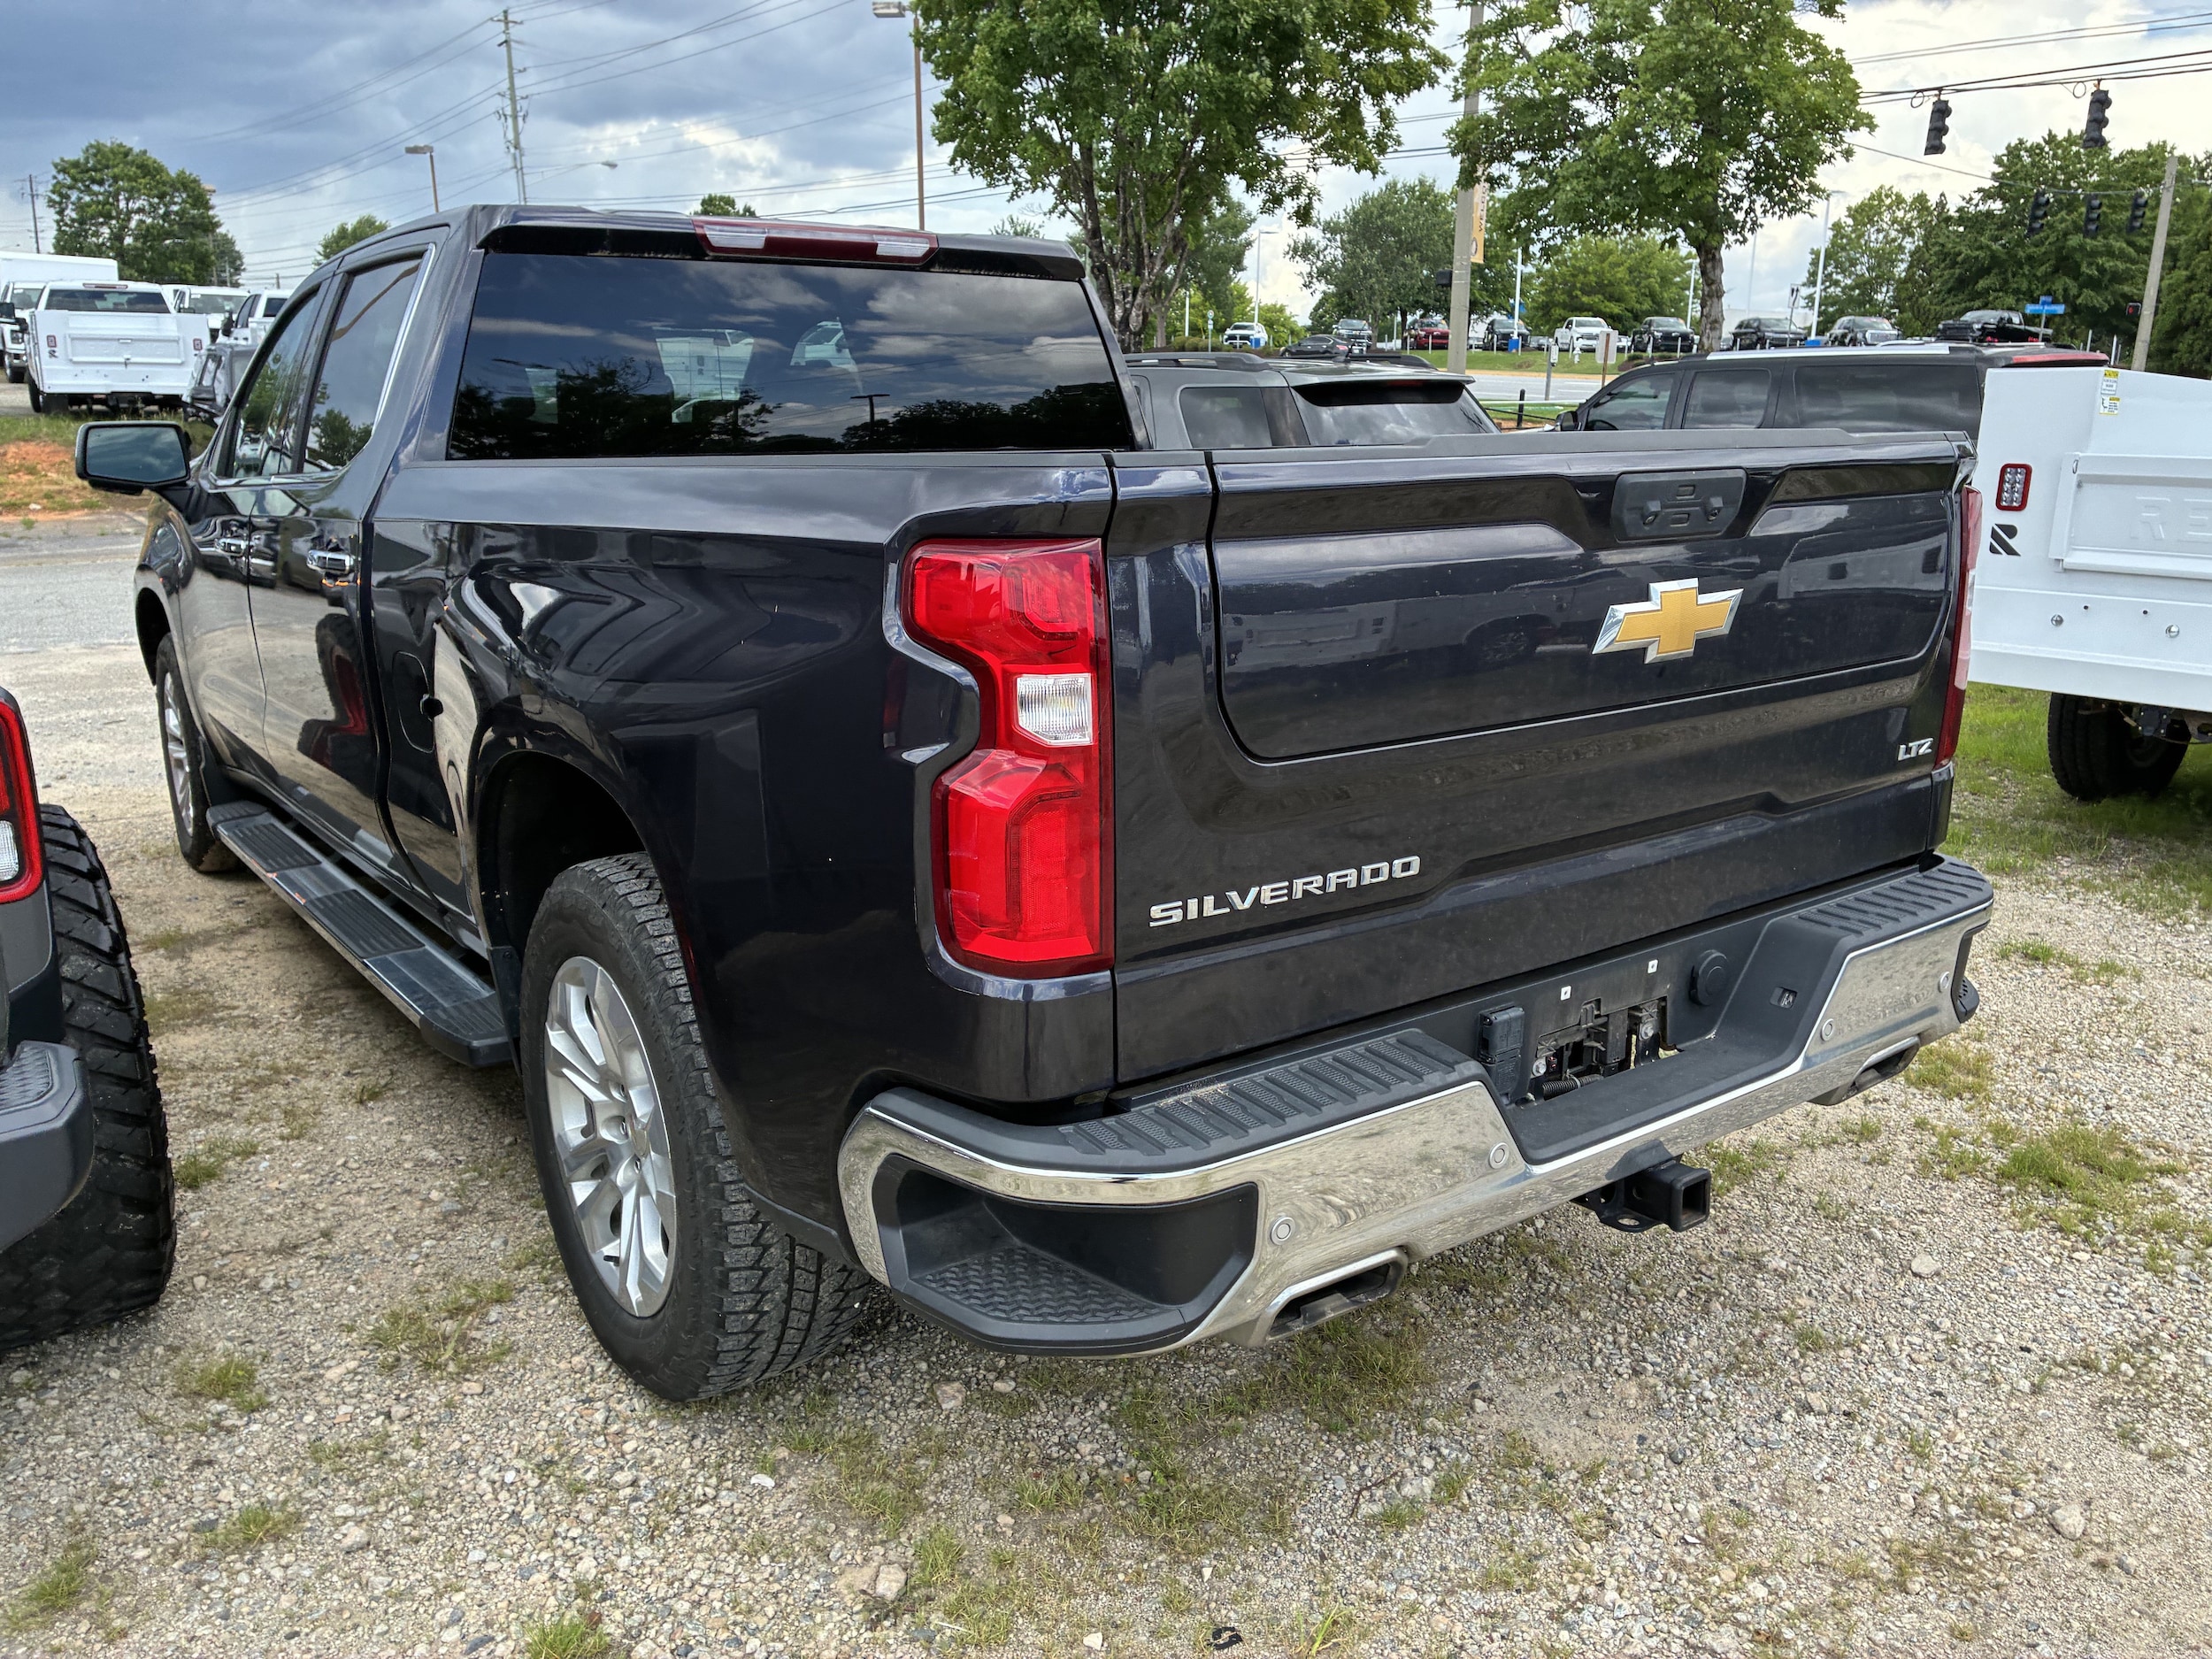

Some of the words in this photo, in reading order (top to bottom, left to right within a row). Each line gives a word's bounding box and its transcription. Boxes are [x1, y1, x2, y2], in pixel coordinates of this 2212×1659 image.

[1479, 184, 1487, 232] WELCO
[1897, 737, 1934, 761] LTZ
[1149, 855, 1421, 927] SILVERADO
